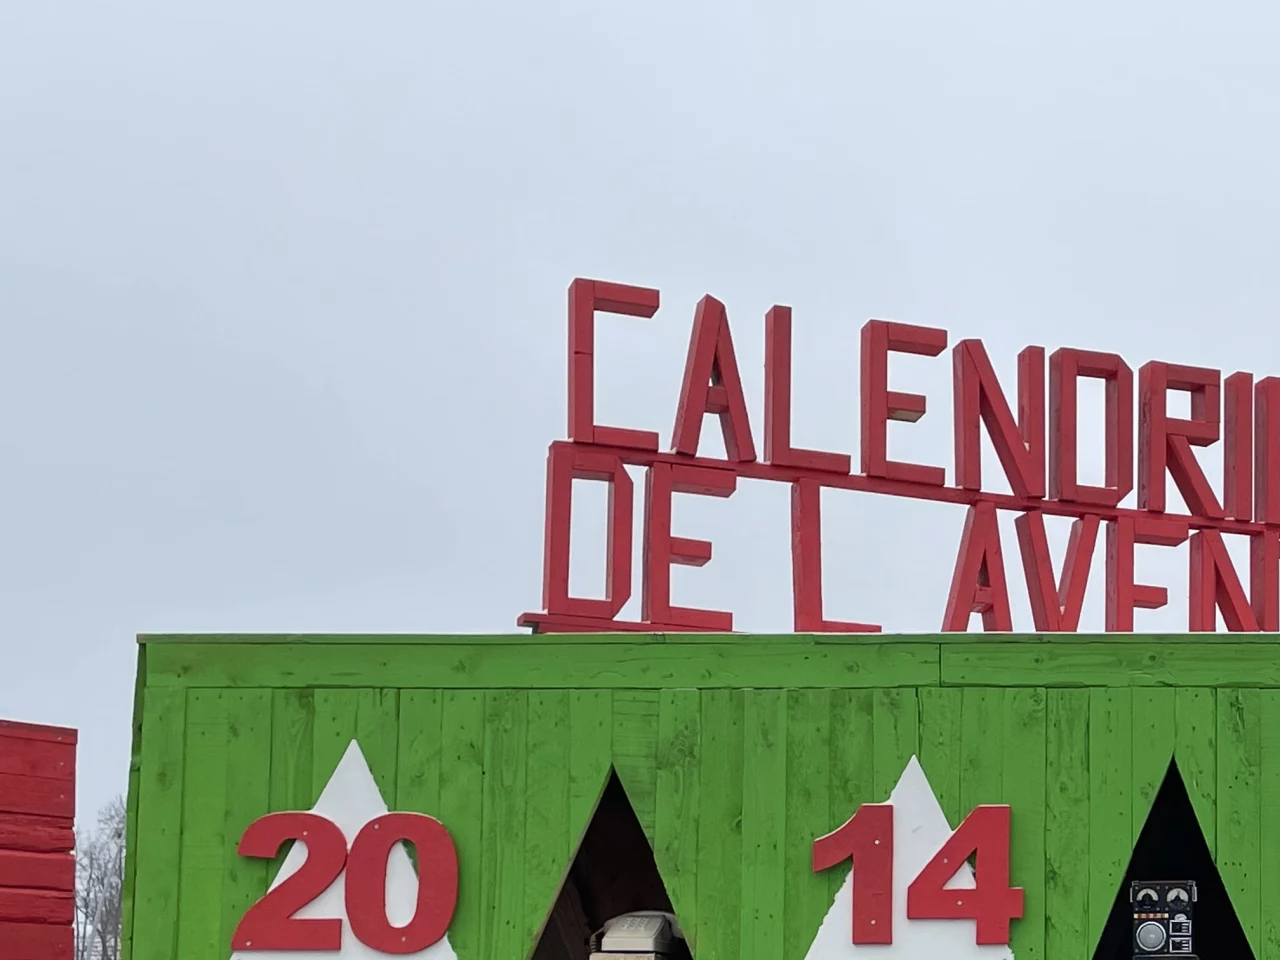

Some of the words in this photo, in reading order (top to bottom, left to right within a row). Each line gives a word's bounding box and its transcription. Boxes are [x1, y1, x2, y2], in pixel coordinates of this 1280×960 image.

[543, 446, 738, 627] DE
[230, 810, 459, 955] 20
[812, 803, 1025, 945] 14
